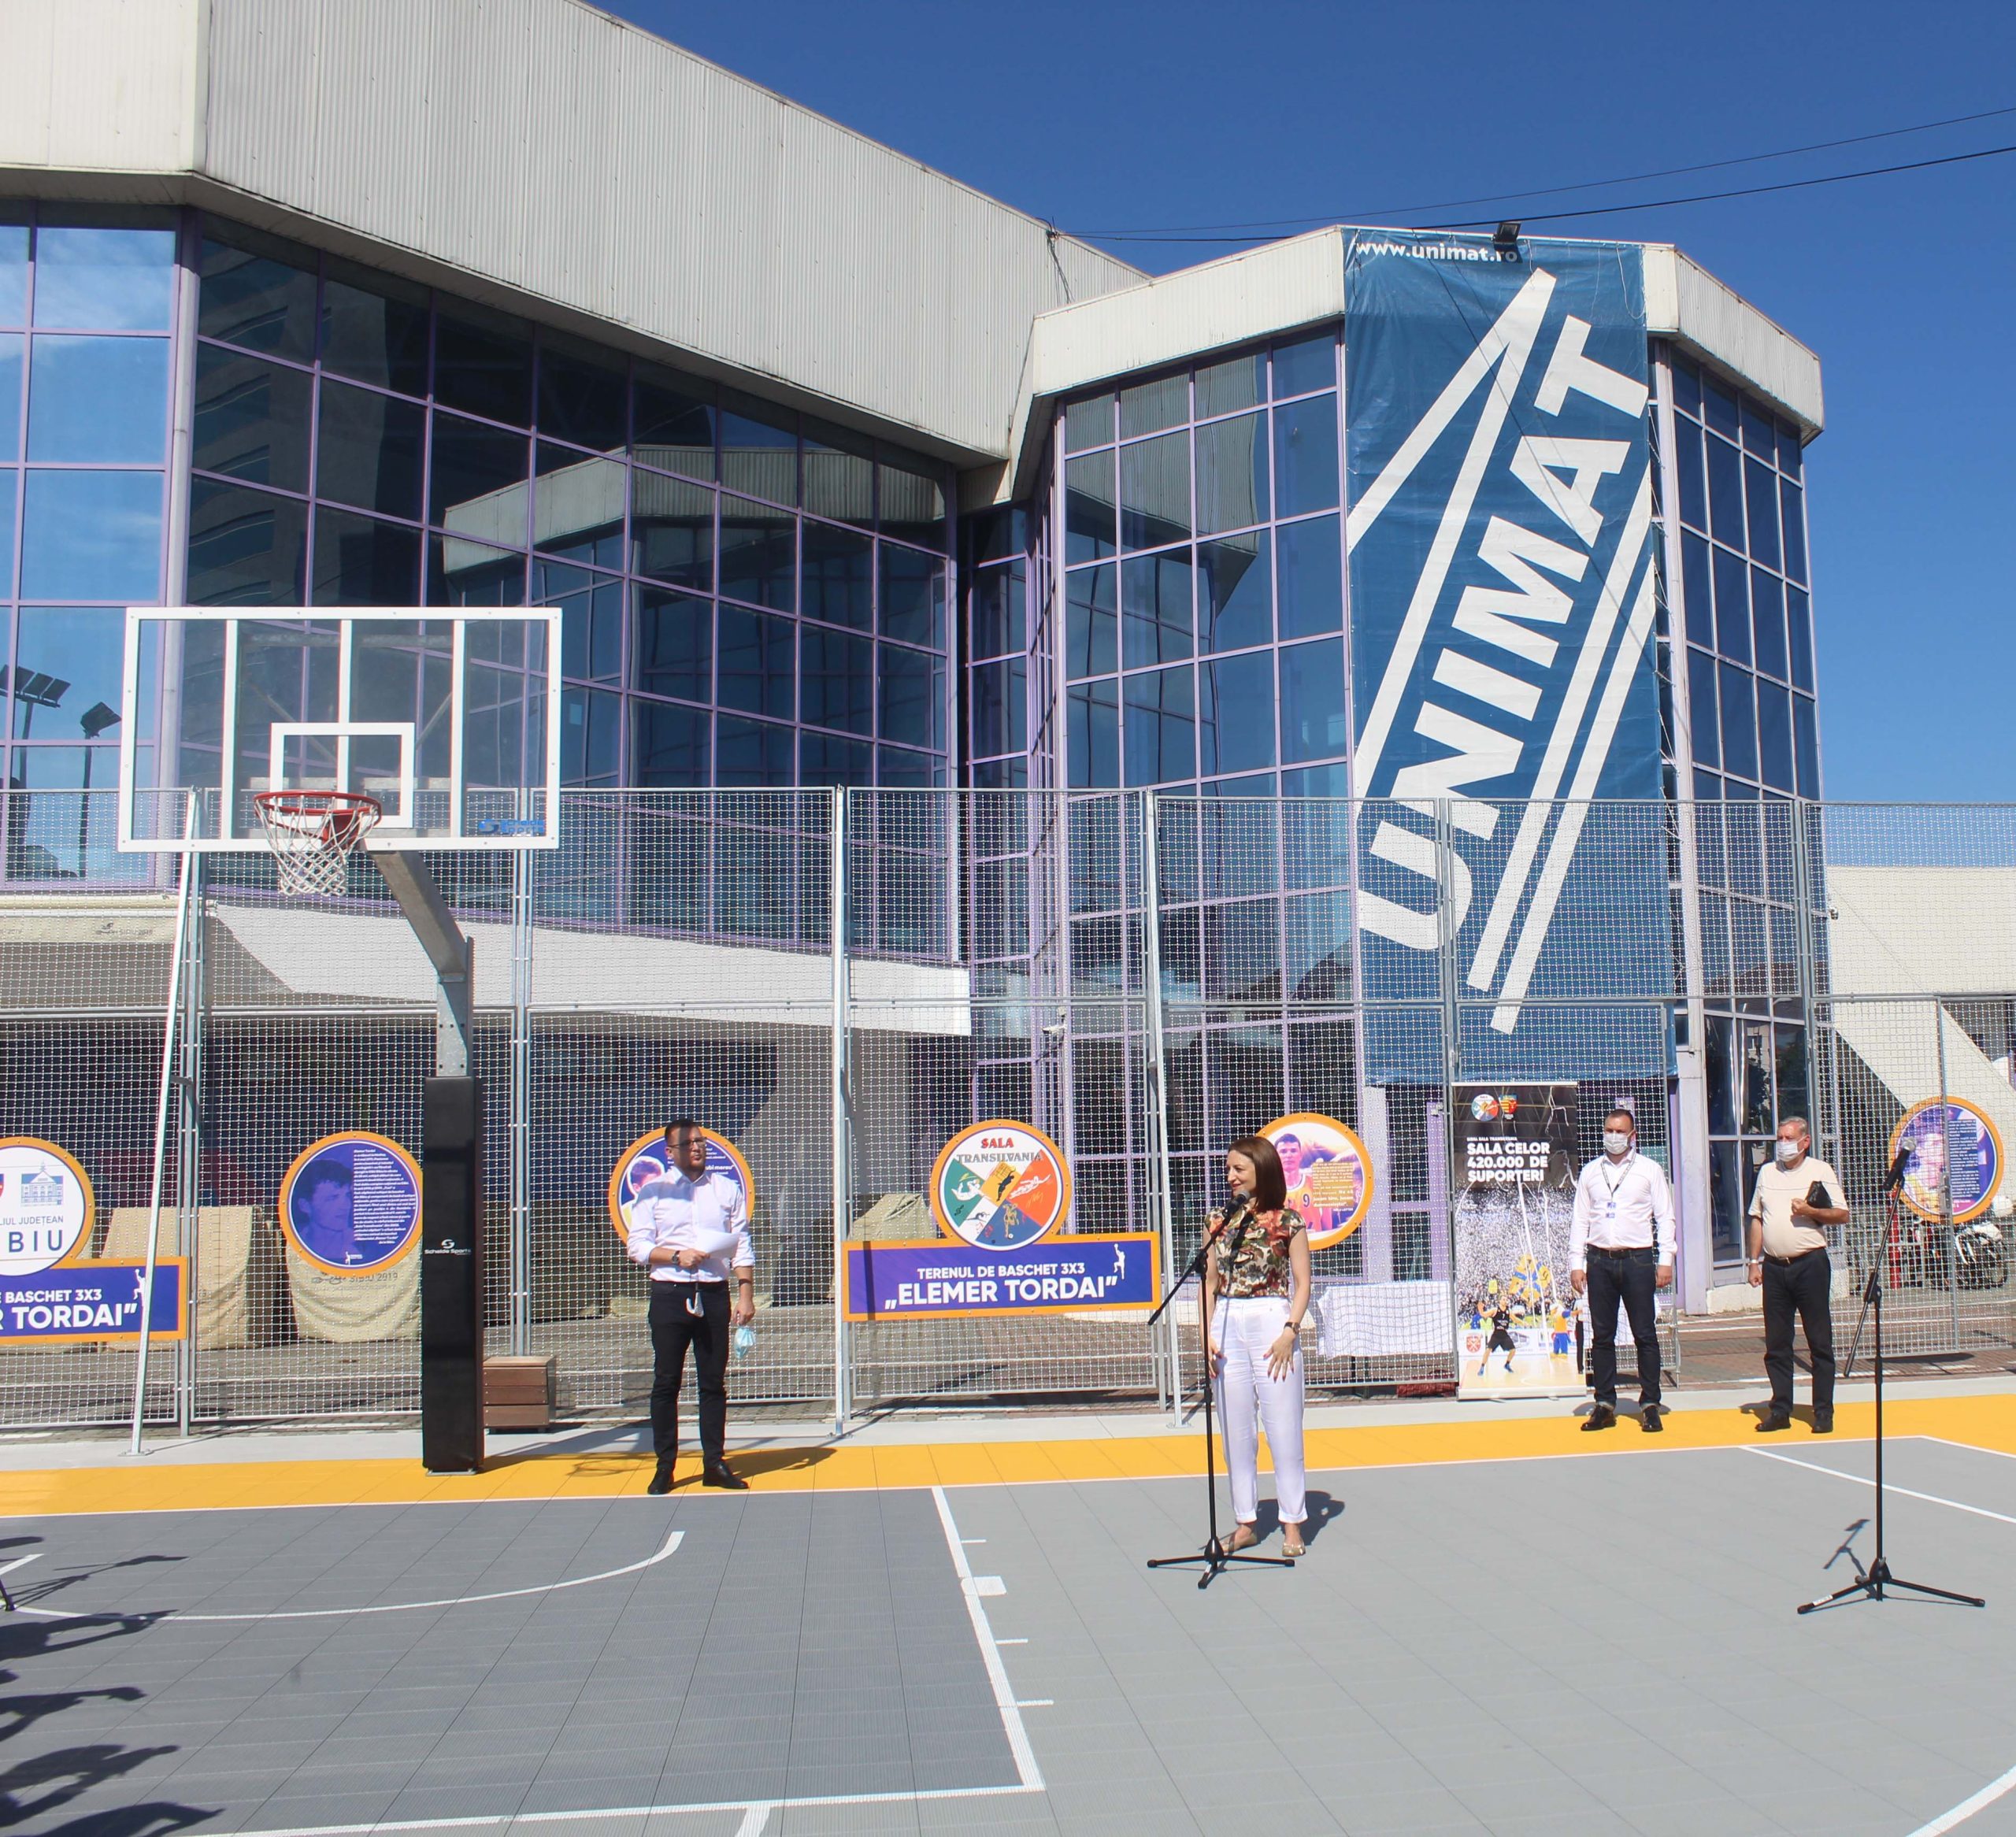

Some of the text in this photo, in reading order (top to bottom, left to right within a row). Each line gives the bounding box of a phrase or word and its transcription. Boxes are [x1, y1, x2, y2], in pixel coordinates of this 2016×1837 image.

[1356, 243, 1518, 262] www.unimat.ro
[1359, 316, 1648, 950] UNIMAT
[980, 1137, 1014, 1149] SALA
[1467, 1142, 1550, 1155] SALA CELOR
[956, 1152, 1043, 1163] TRANSILVANIA
[1467, 1155, 1548, 1168] 420.000 DE
[1467, 1169, 1544, 1182] SUPORTERI
[1303, 1194, 1310, 1207] 9
[19, 1215, 63, 1225] JUDEȚEAN
[917, 1262, 1085, 1280] TERENUL DE BASCHET 3X3
[6, 1289, 72, 1303] BASCHET
[75, 1288, 102, 1302] 3X3
